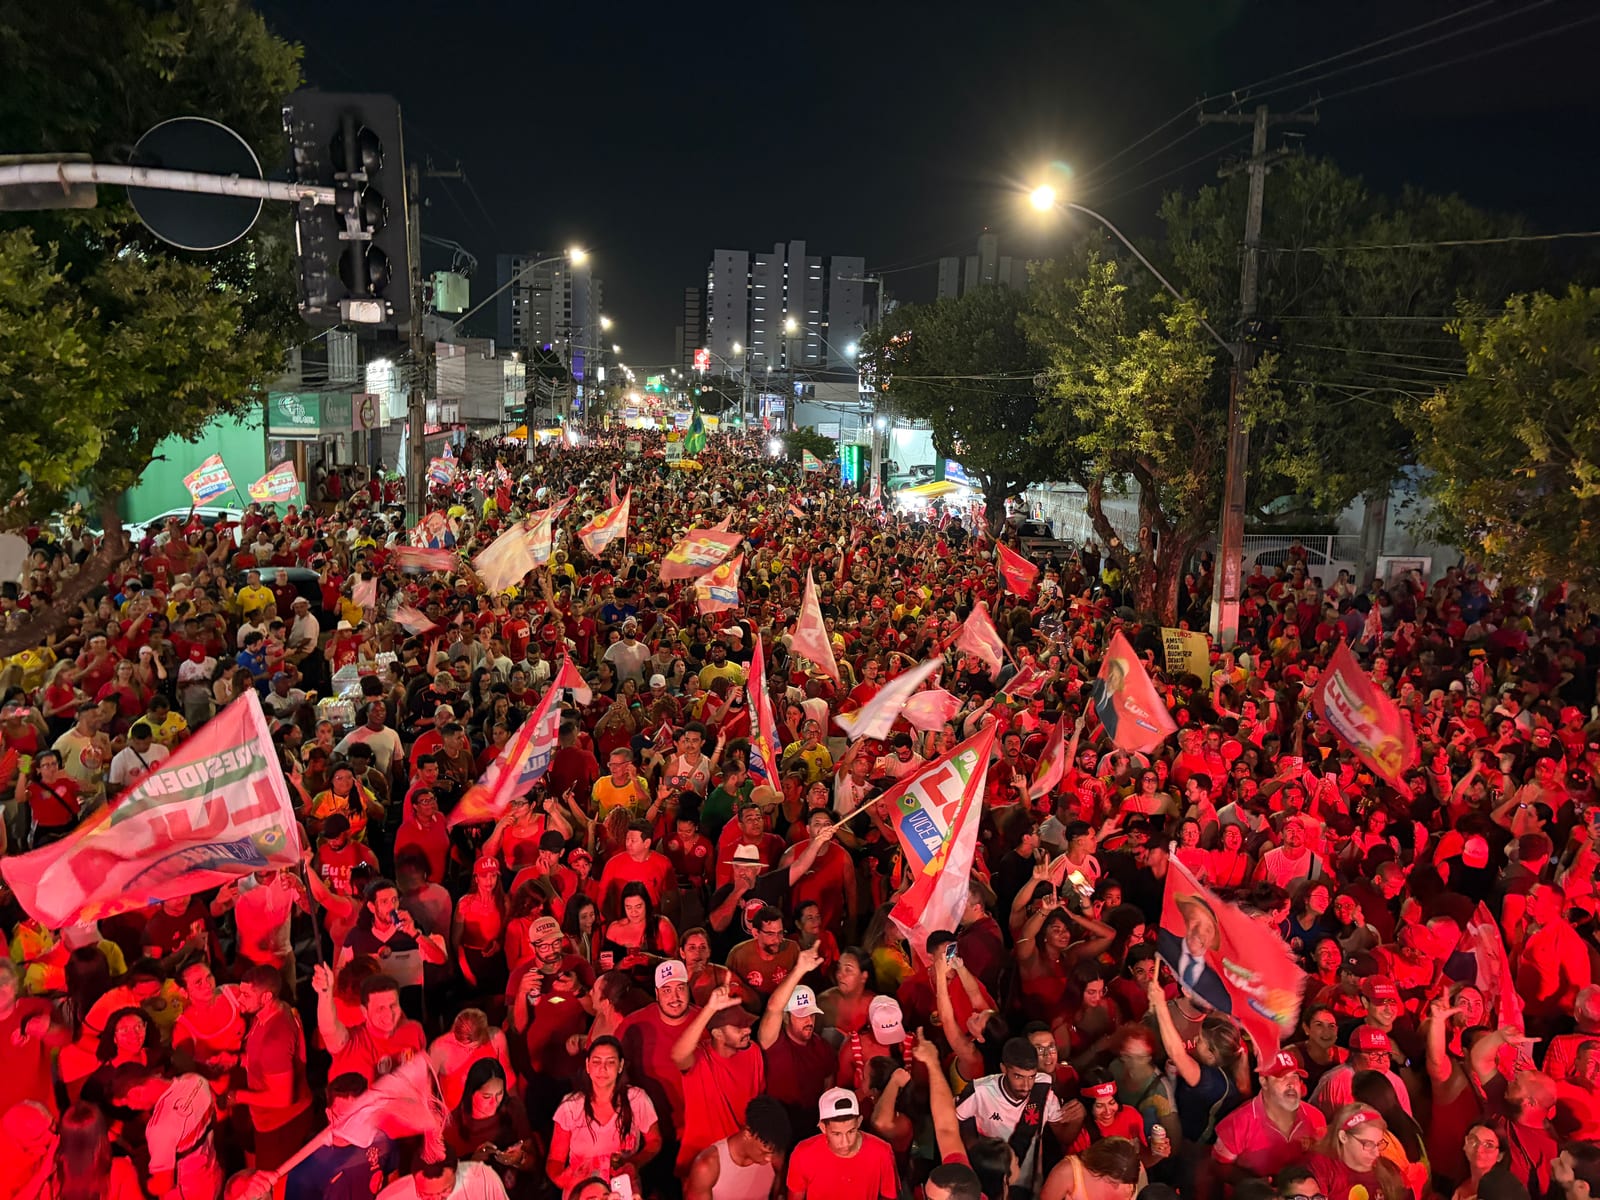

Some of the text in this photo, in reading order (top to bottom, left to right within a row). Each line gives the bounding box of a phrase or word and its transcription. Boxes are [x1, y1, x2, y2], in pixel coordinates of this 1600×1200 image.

[908, 811, 938, 838] VICE
[321, 864, 339, 876] Eu
[662, 971, 673, 979] LA
[881, 1021, 898, 1029] LULA
[1277, 1052, 1294, 1066] 13
